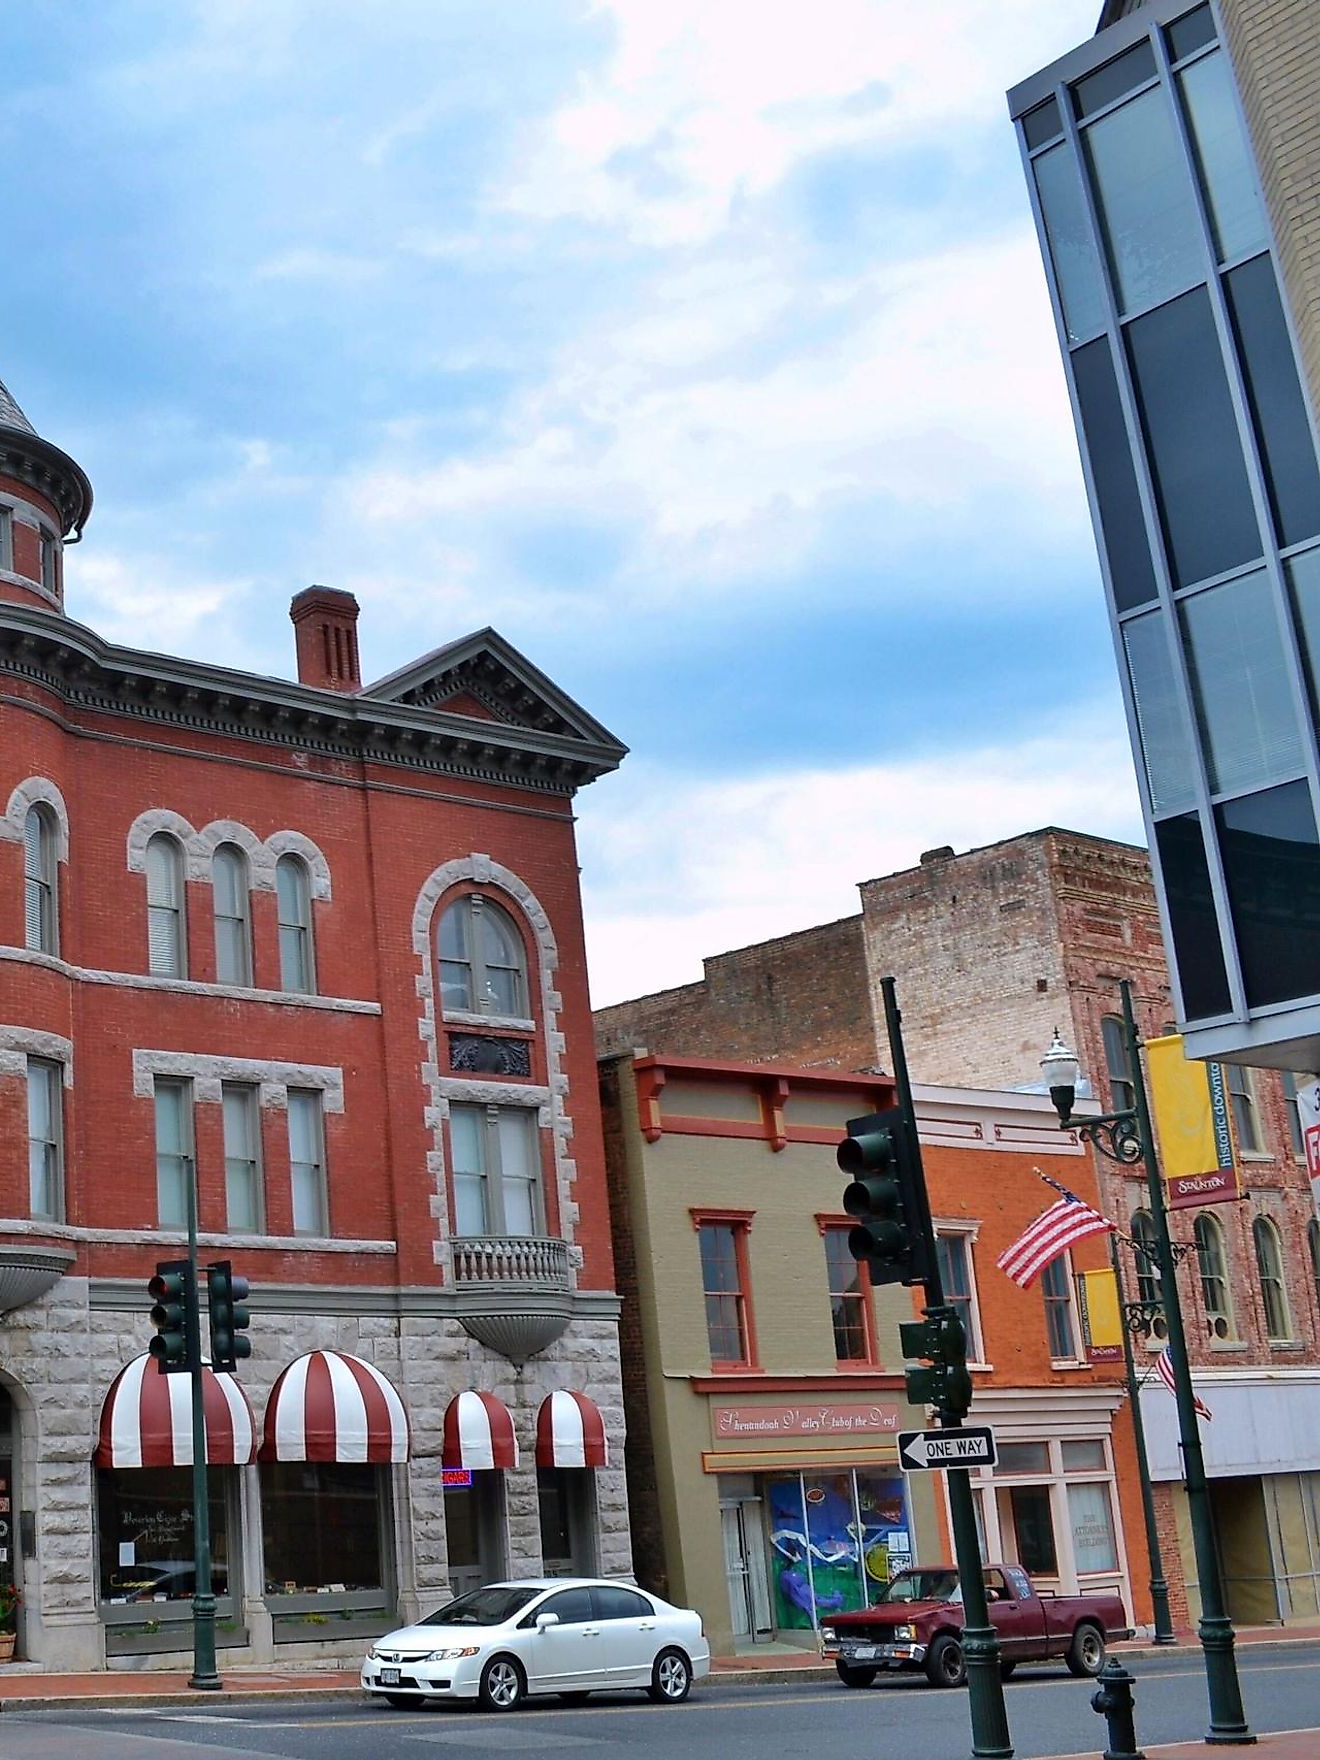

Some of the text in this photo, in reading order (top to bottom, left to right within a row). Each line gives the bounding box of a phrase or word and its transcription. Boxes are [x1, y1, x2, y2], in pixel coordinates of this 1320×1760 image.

[1216, 1121, 1232, 1168] historic
[855, 1417, 868, 1427] the
[926, 1439, 983, 1457] ONE WAY
[443, 1471, 469, 1484] IGARS
